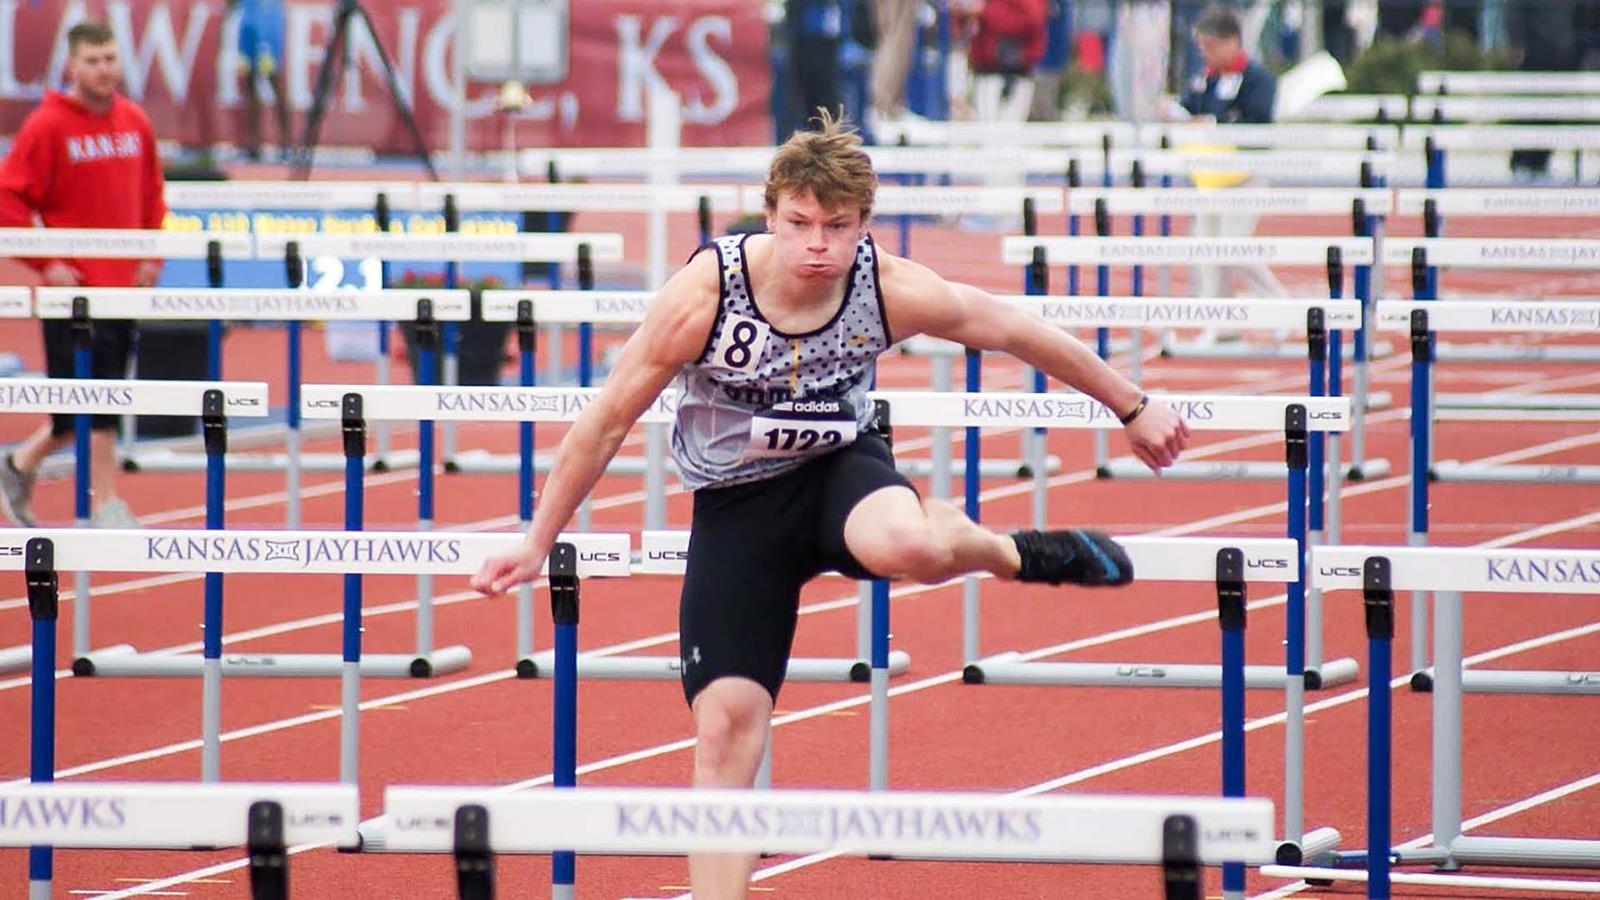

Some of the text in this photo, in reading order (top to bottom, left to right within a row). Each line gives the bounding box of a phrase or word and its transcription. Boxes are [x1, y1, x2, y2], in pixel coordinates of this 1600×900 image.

[615, 14, 739, 126] KS
[595, 298, 649, 312] KANS
[1042, 303, 1249, 322] KANSAS JAYHAWKS
[1490, 308, 1568, 324] KANSAS
[724, 320, 758, 368] 8
[7, 385, 133, 408] JAYHAWKS
[436, 392, 527, 411] KANSAS
[794, 401, 840, 412] adidas
[964, 399, 1053, 418] KANSAS
[147, 537, 260, 561] KANSAS
[302, 538, 461, 568] JAYHAWKS
[580, 552, 620, 561] UCS
[648, 551, 688, 560] UCS
[1247, 559, 1288, 568] UCS
[1320, 567, 1361, 576] UCS
[1486, 558, 1600, 583] KANSAS
[0, 797, 127, 830] AWKS
[616, 804, 1043, 842] KANSAS JAYHAWKS
